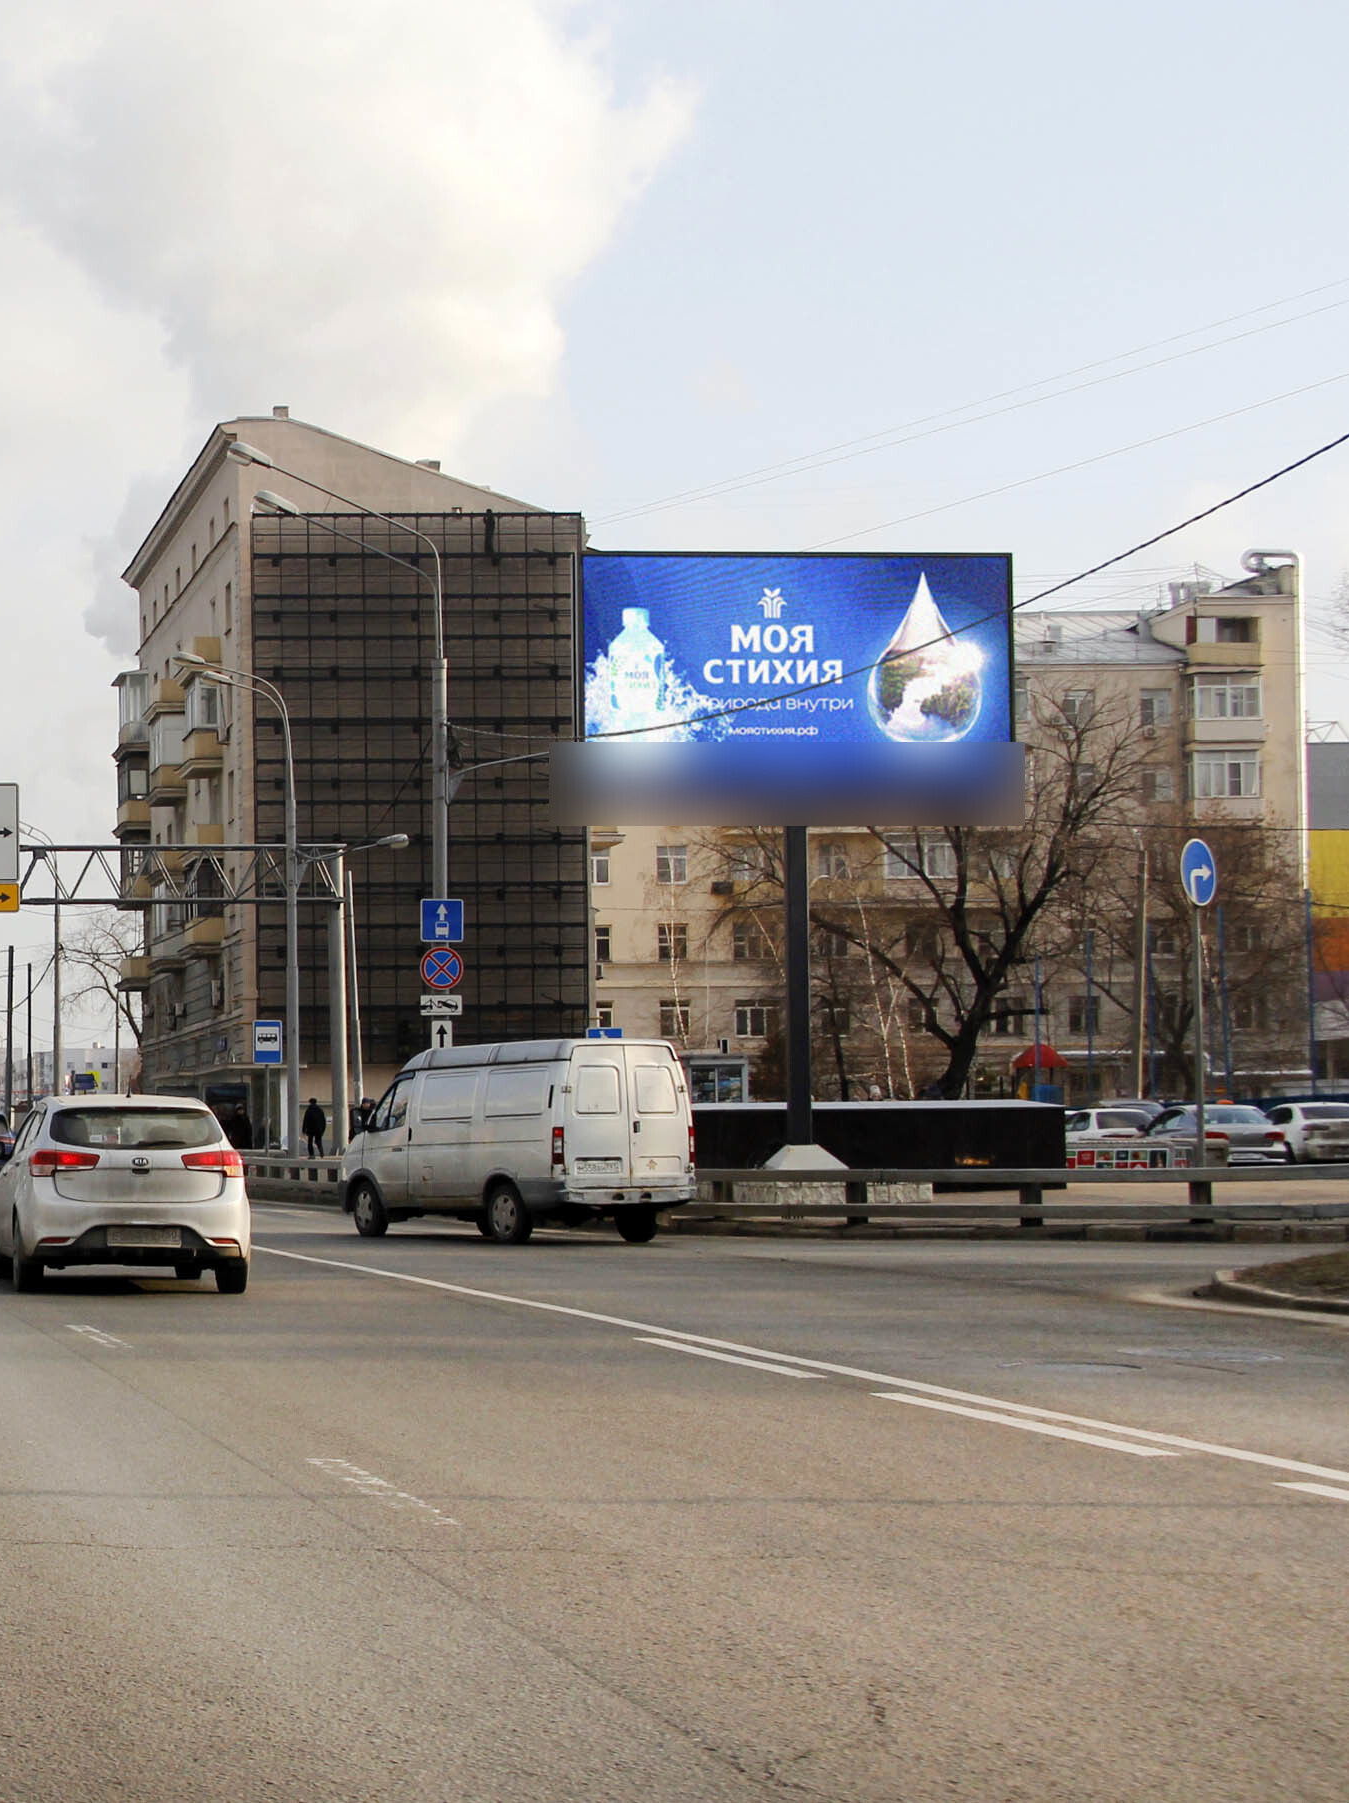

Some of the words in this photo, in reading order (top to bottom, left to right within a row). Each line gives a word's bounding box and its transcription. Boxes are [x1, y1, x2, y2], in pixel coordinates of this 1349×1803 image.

[731, 625, 814, 653] МОЯ
[703, 659, 844, 685] СТИХИЯ
[785, 697, 854, 712] внутри
